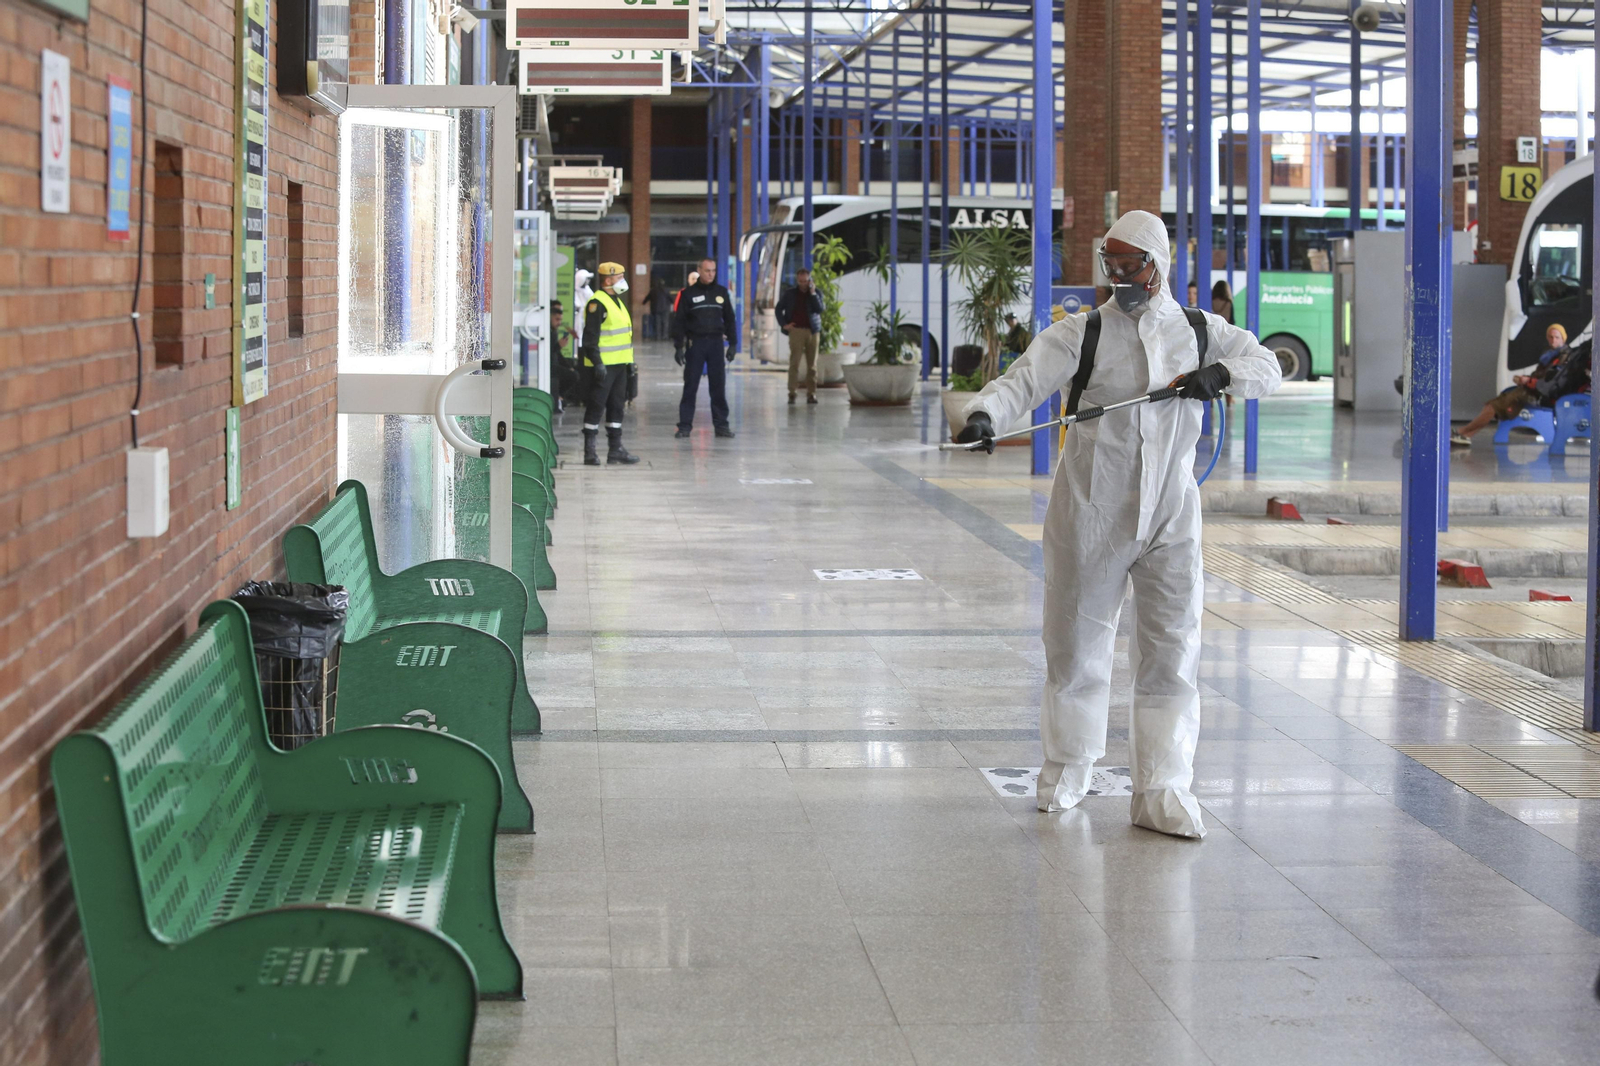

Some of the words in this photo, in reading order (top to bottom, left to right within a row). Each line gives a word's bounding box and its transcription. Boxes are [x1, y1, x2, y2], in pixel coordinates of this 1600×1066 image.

[1521, 148, 1534, 160] 18
[588, 169, 599, 177] 16
[1507, 173, 1538, 199] 18
[951, 208, 1029, 229] ALSA
[1262, 284, 1304, 294] Transportes
[1261, 292, 1314, 305] Andalucía
[396, 645, 457, 667] EMT
[258, 946, 369, 986] EMT
